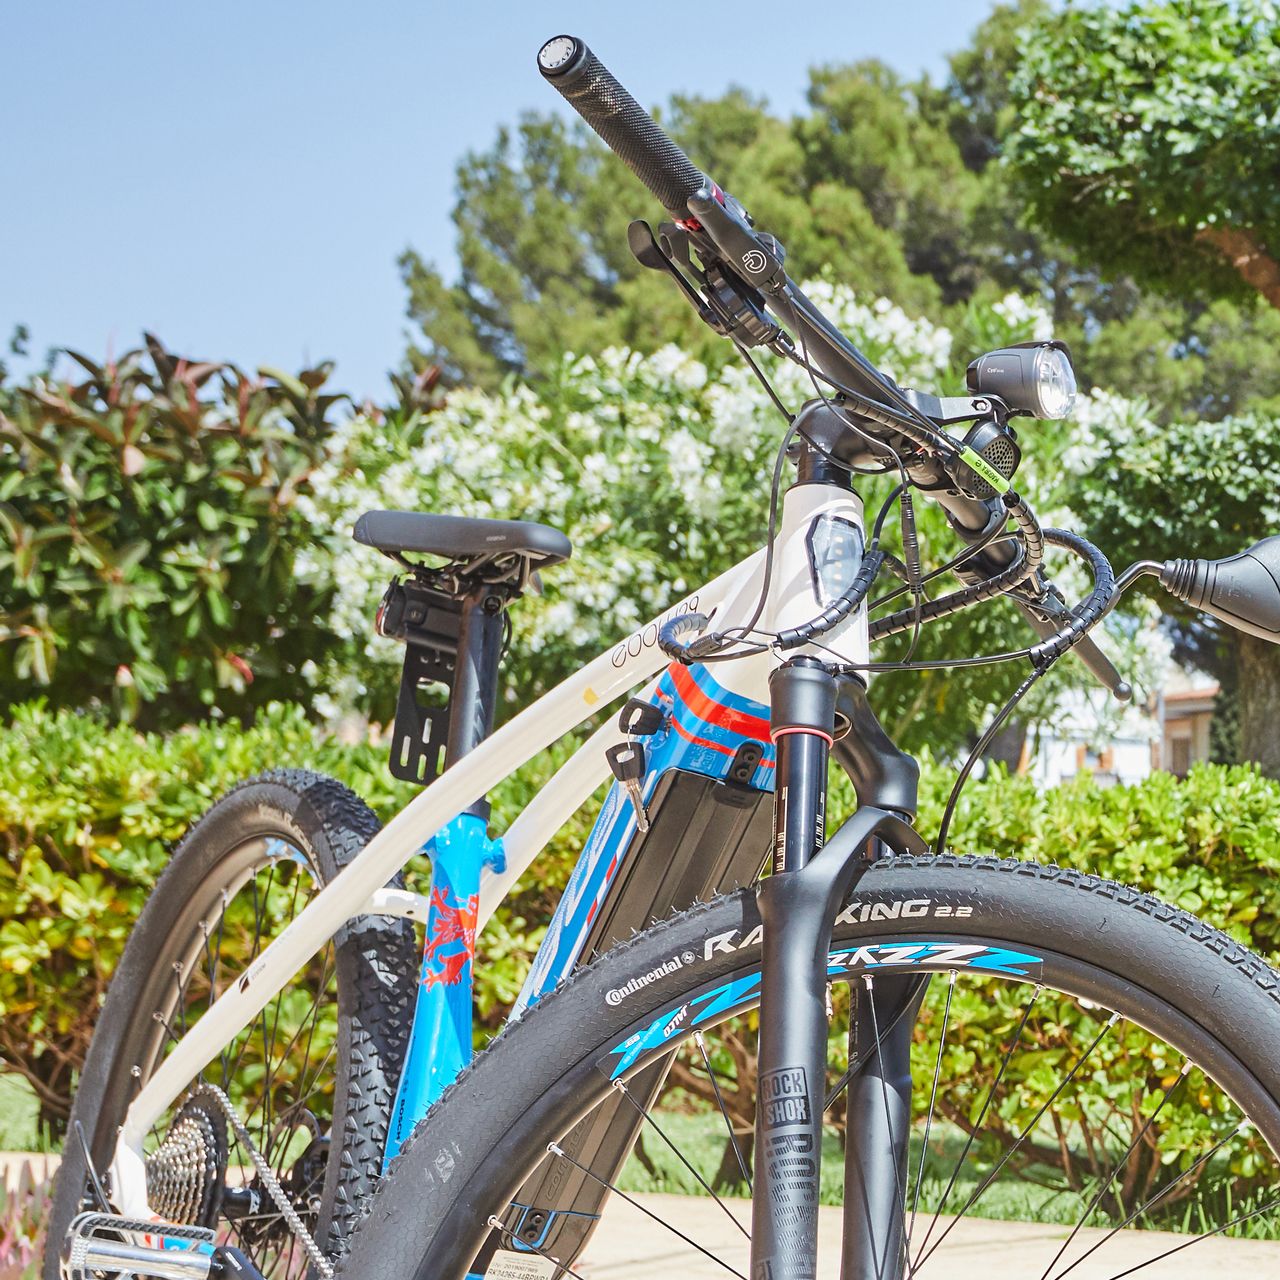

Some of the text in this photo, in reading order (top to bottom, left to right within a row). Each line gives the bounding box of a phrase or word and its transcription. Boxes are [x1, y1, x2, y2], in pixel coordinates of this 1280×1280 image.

[703, 923, 764, 962] RA
[933, 905, 973, 919] 2.2
[604, 958, 683, 1007] Continental
[761, 1070, 802, 1100] ROCK
[766, 1096, 808, 1124] SHOX
